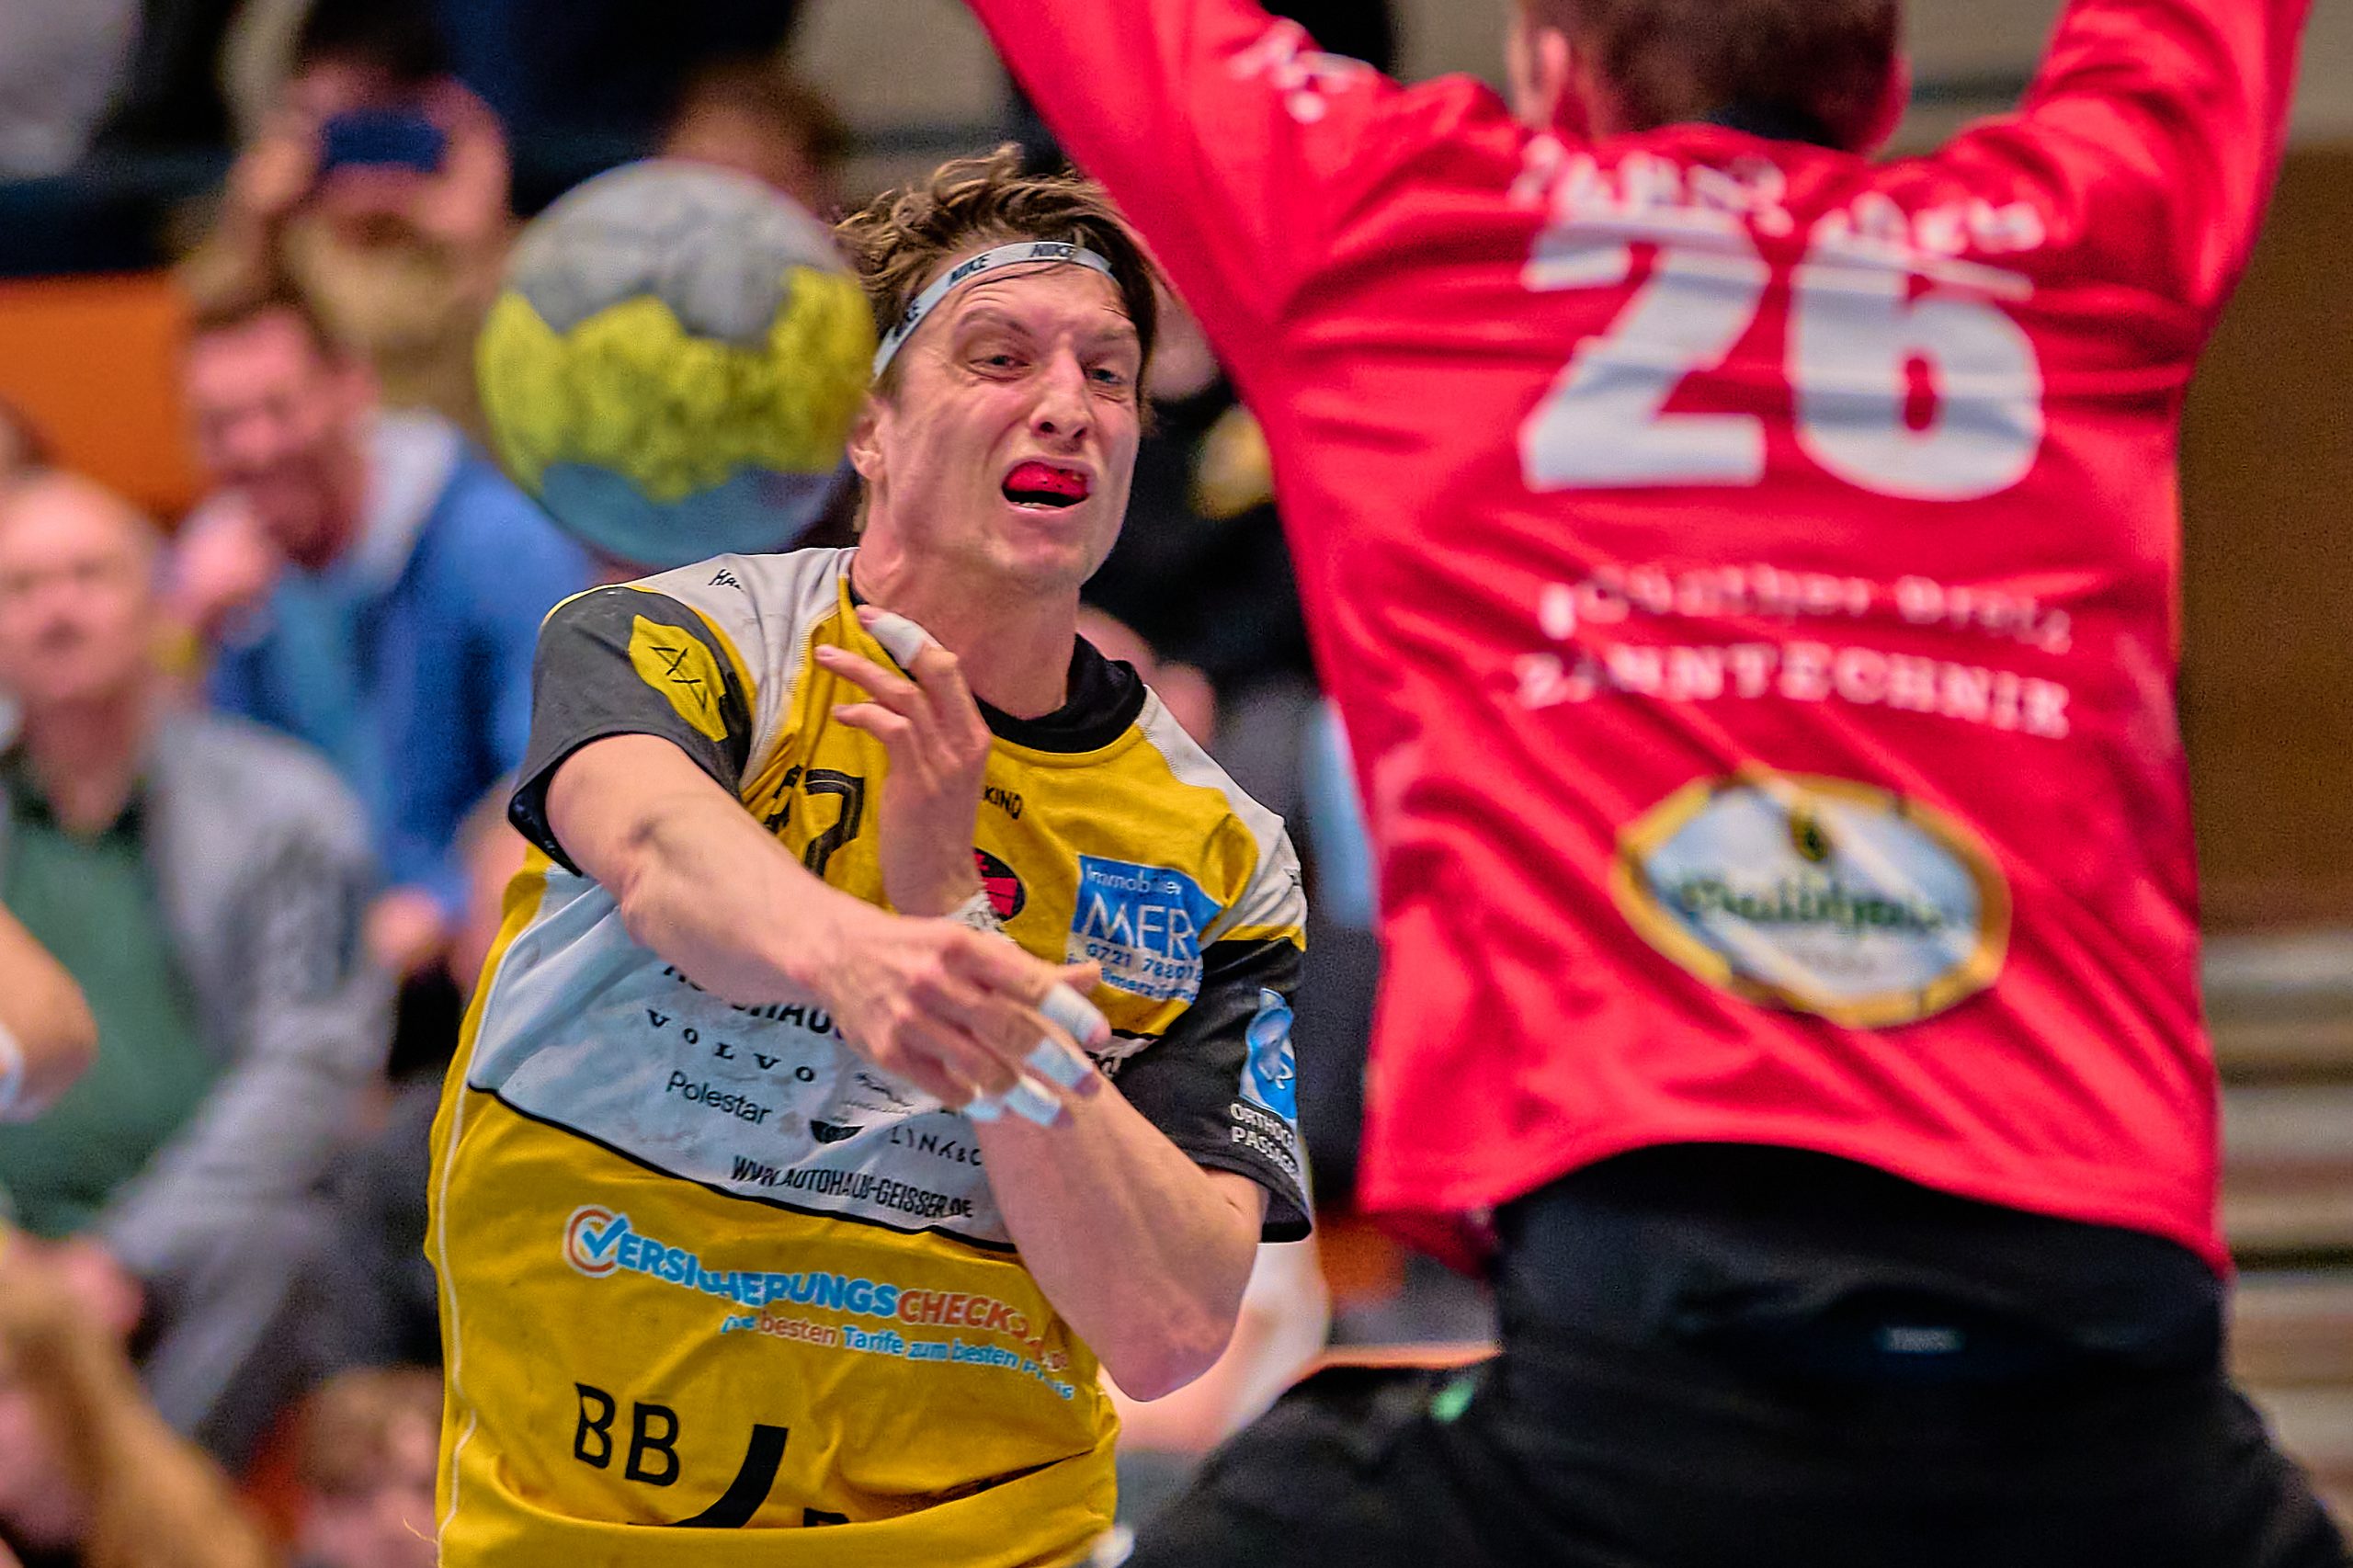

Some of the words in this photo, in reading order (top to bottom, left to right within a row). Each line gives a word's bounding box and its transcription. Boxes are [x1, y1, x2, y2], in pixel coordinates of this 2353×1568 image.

[1518, 208, 2046, 502] 26
[646, 1008, 815, 1083] VOLVO
[665, 1070, 772, 1125] Polestar
[761, 1310, 837, 1347] besten
[842, 1324, 904, 1356] Tarife
[906, 1339, 948, 1362] zum
[950, 1338, 1020, 1370] besten
[574, 1381, 679, 1487] BB
